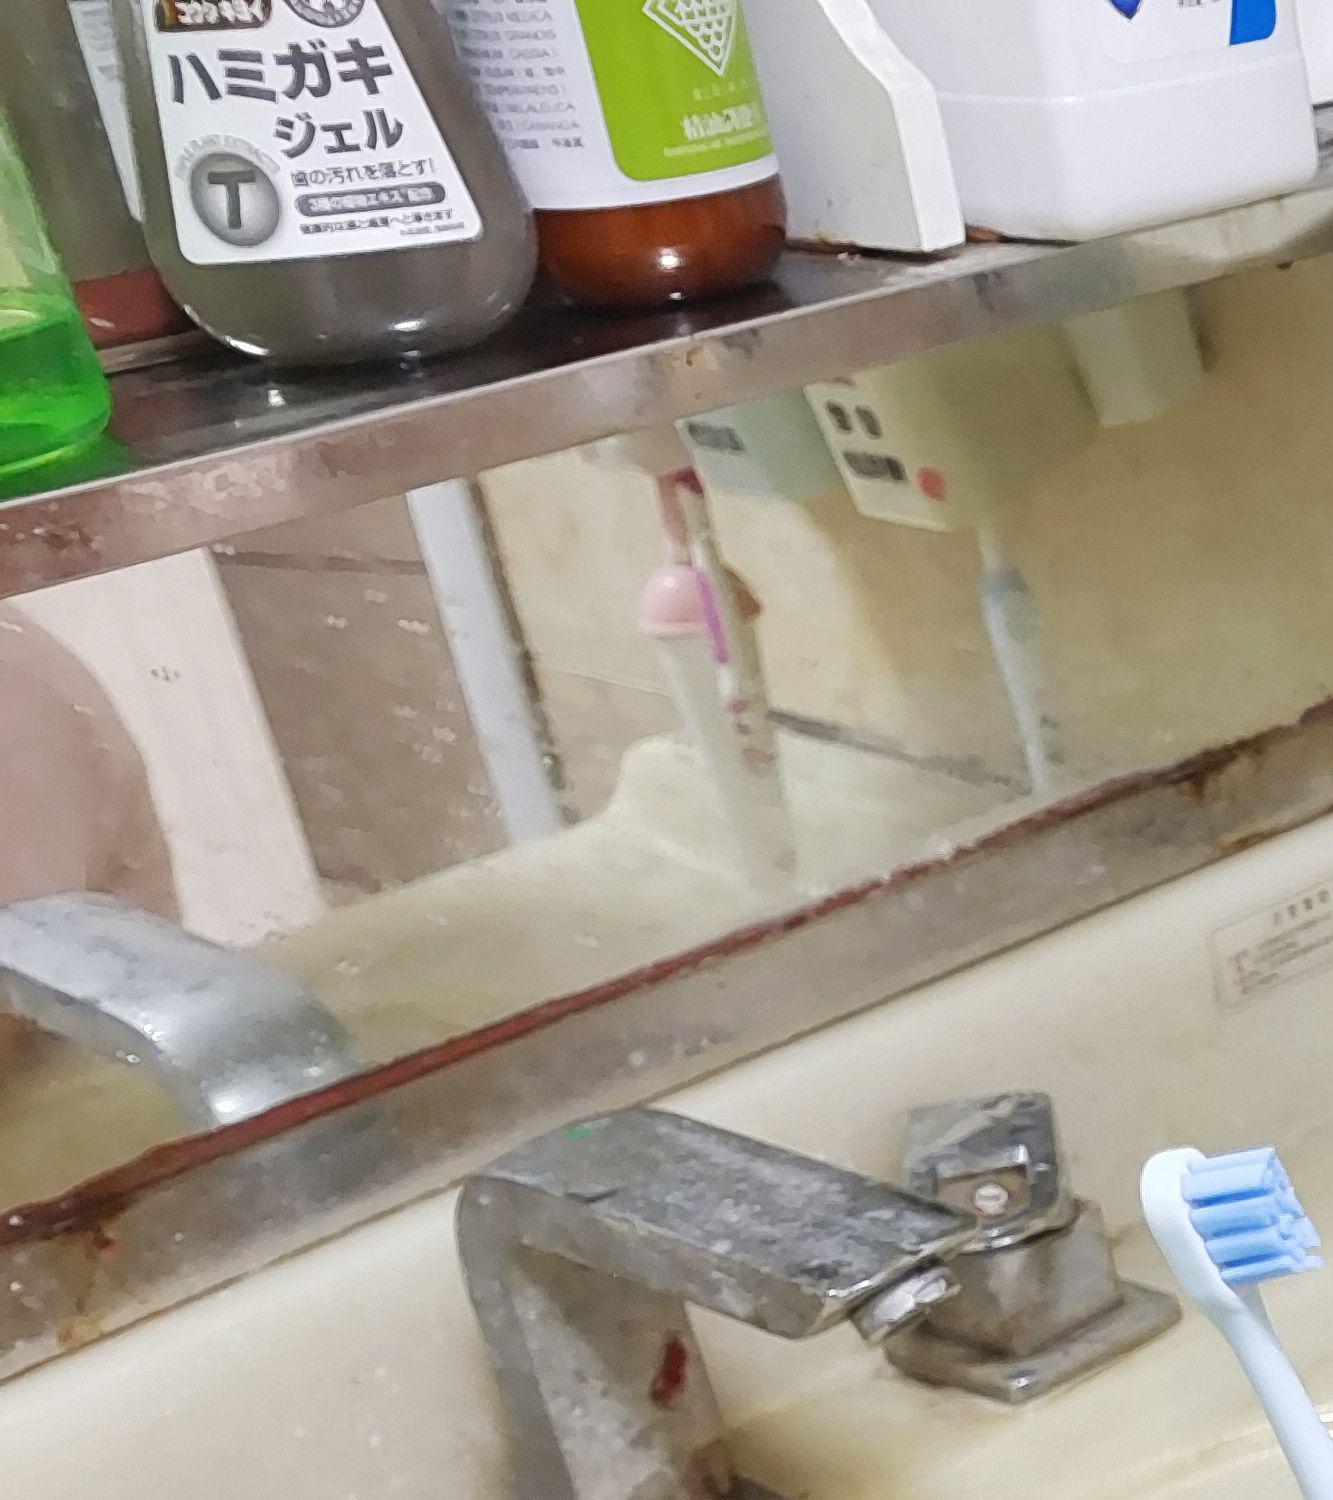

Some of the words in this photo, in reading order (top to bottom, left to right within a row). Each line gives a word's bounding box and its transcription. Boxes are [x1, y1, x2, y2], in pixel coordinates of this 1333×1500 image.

[168, 38, 393, 104] ハミガキ
[274, 108, 404, 159] ジェル
[208, 169, 257, 230] T
